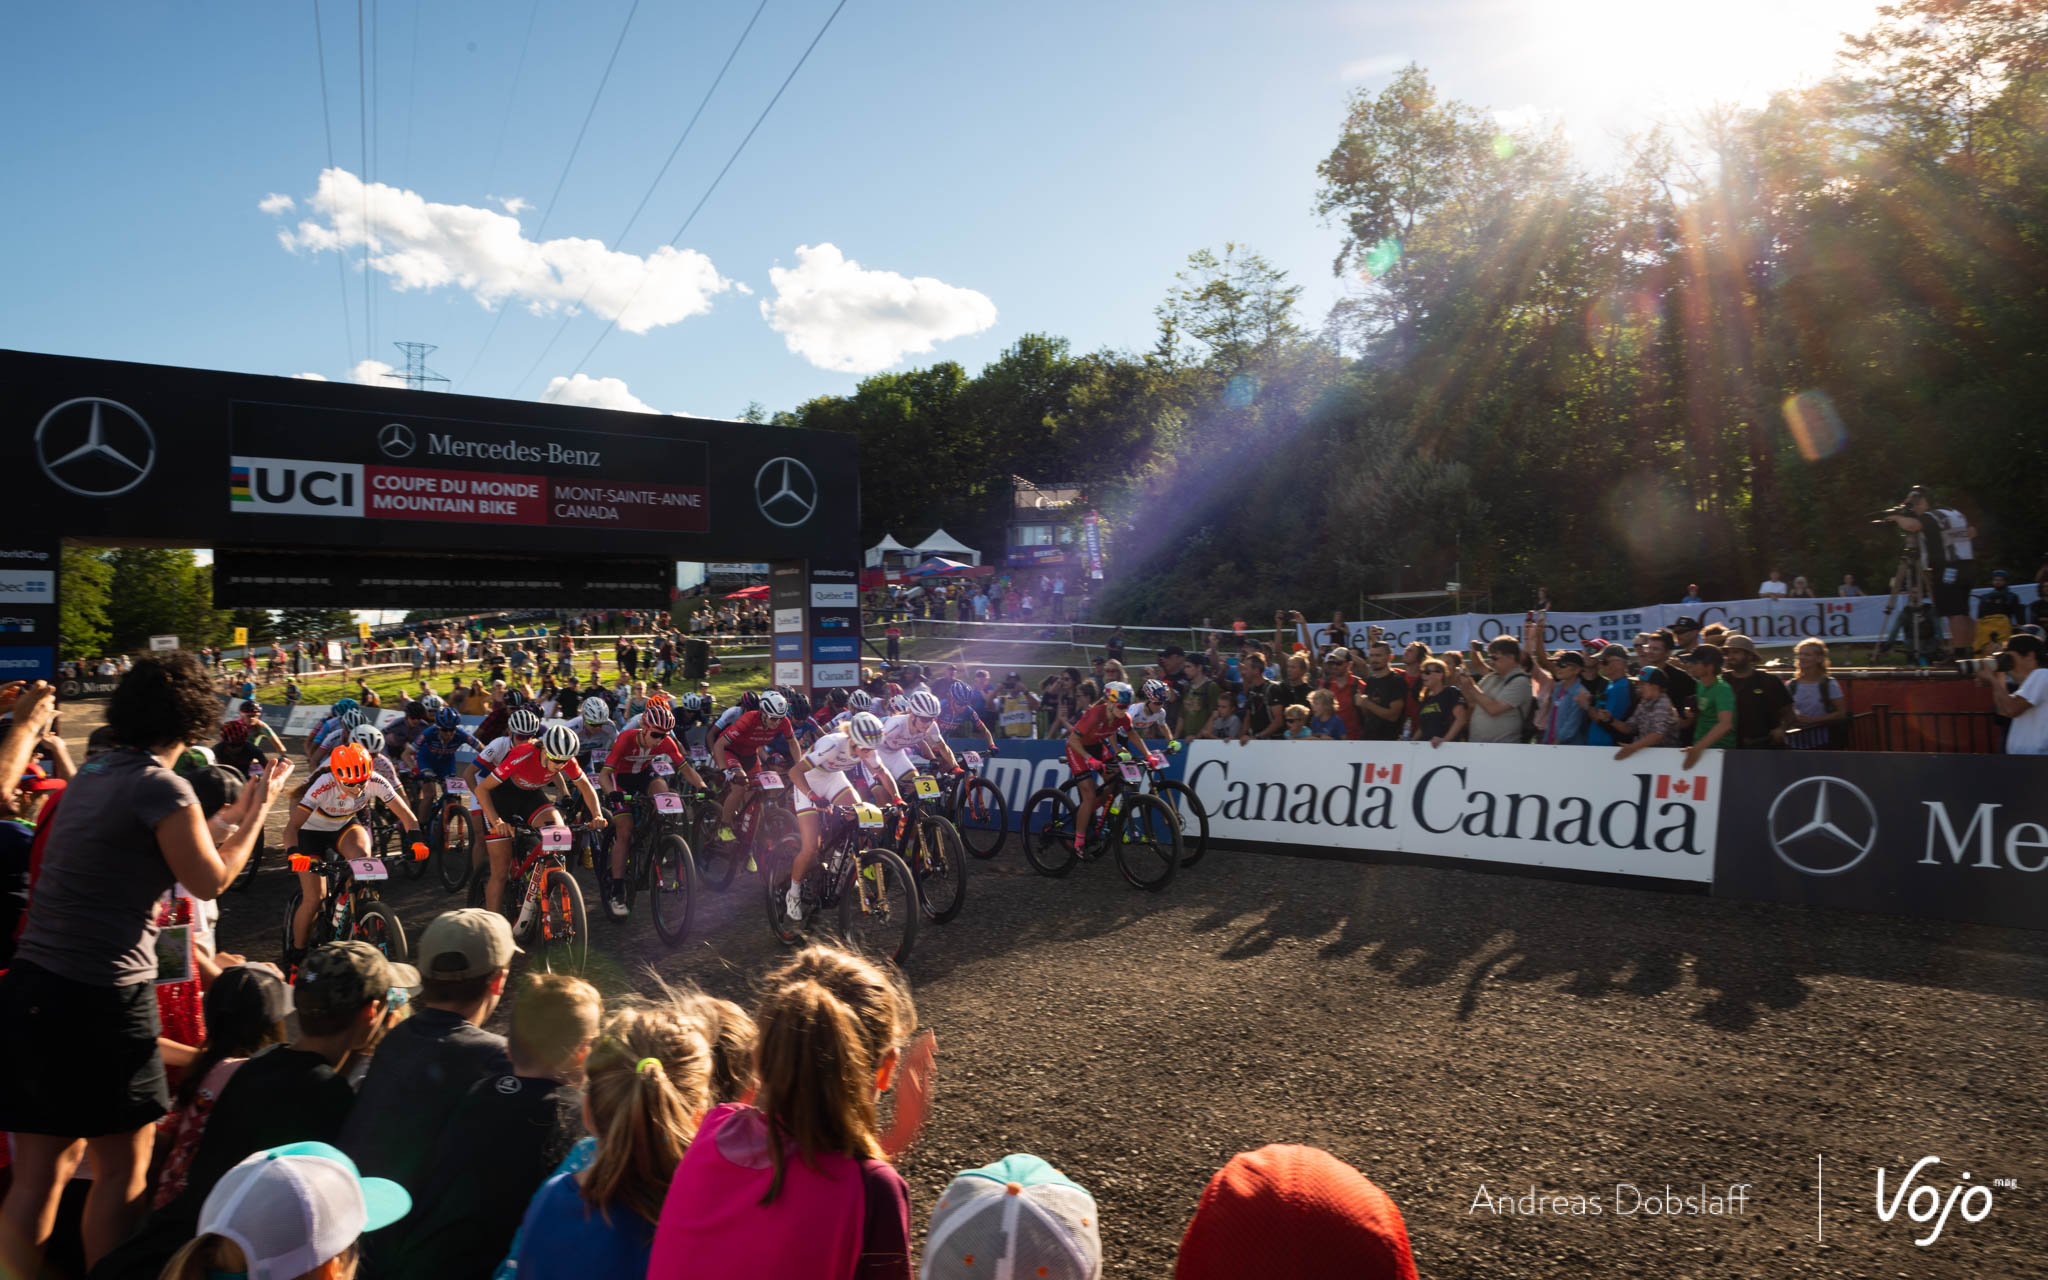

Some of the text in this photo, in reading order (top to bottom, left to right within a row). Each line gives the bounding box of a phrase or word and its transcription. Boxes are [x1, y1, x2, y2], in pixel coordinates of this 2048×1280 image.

[428, 433, 600, 467] Mercedes-Benz
[255, 467, 353, 507] UCI
[373, 475, 539, 498] COUPE DU MONDE
[555, 486, 701, 508] MONT-SAINTE-ANNE
[373, 494, 518, 515] MOUNTAIN BIKE
[555, 503, 619, 520] CANADA
[1700, 602, 1852, 638] Canada
[451, 781, 464, 789] 22
[923, 781, 931, 793] 3
[1187, 760, 1398, 830] Canada
[665, 798, 673, 808] 2
[1412, 765, 1705, 855] Canada
[864, 808, 872, 820] 1
[553, 831, 562, 843] 6
[1917, 800, 2048, 873] Me
[362, 862, 374, 872] 9
